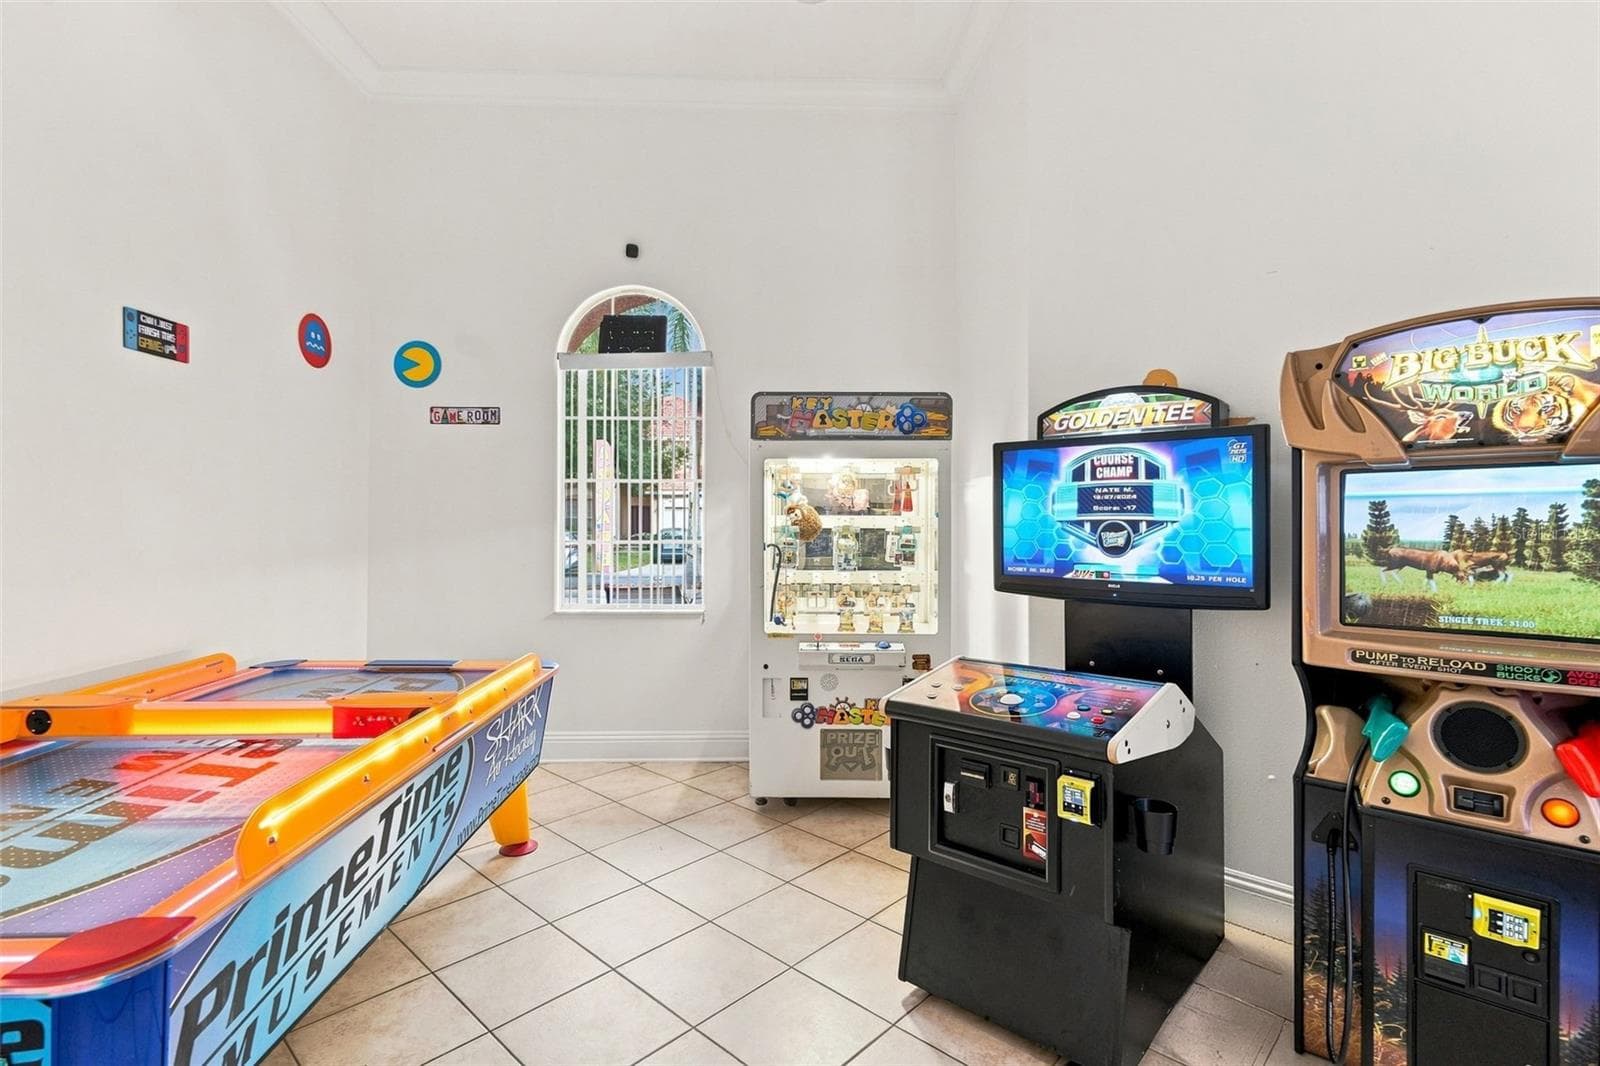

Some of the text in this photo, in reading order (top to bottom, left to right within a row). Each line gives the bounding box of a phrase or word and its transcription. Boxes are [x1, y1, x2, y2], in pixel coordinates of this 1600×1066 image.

[1382, 348, 1462, 391] BIG
[1465, 331, 1597, 372] BUCK
[1419, 371, 1549, 404] WORLD
[791, 396, 832, 409] KEY
[433, 408, 497, 423] GAME ROOM
[788, 409, 897, 431] MASTER
[1054, 403, 1197, 431] GOLDEN TEE
[1094, 453, 1134, 465] COURSE
[1096, 466, 1133, 479] CHAMP
[1438, 615, 1474, 625] SINGLE
[1355, 650, 1487, 672] PUMP TO RELOAD
[1402, 662, 1433, 672] EVERY
[1437, 666, 1463, 674] SHOT
[1496, 664, 1541, 675] SHOOT
[1496, 671, 1541, 682] BUCKS
[484, 682, 543, 762] SHARK
[816, 706, 891, 728] MASTE
[826, 733, 876, 744] PRIZE
[172, 744, 465, 1066] PrimeTime
[221, 790, 457, 1066] MUSEMENTS
